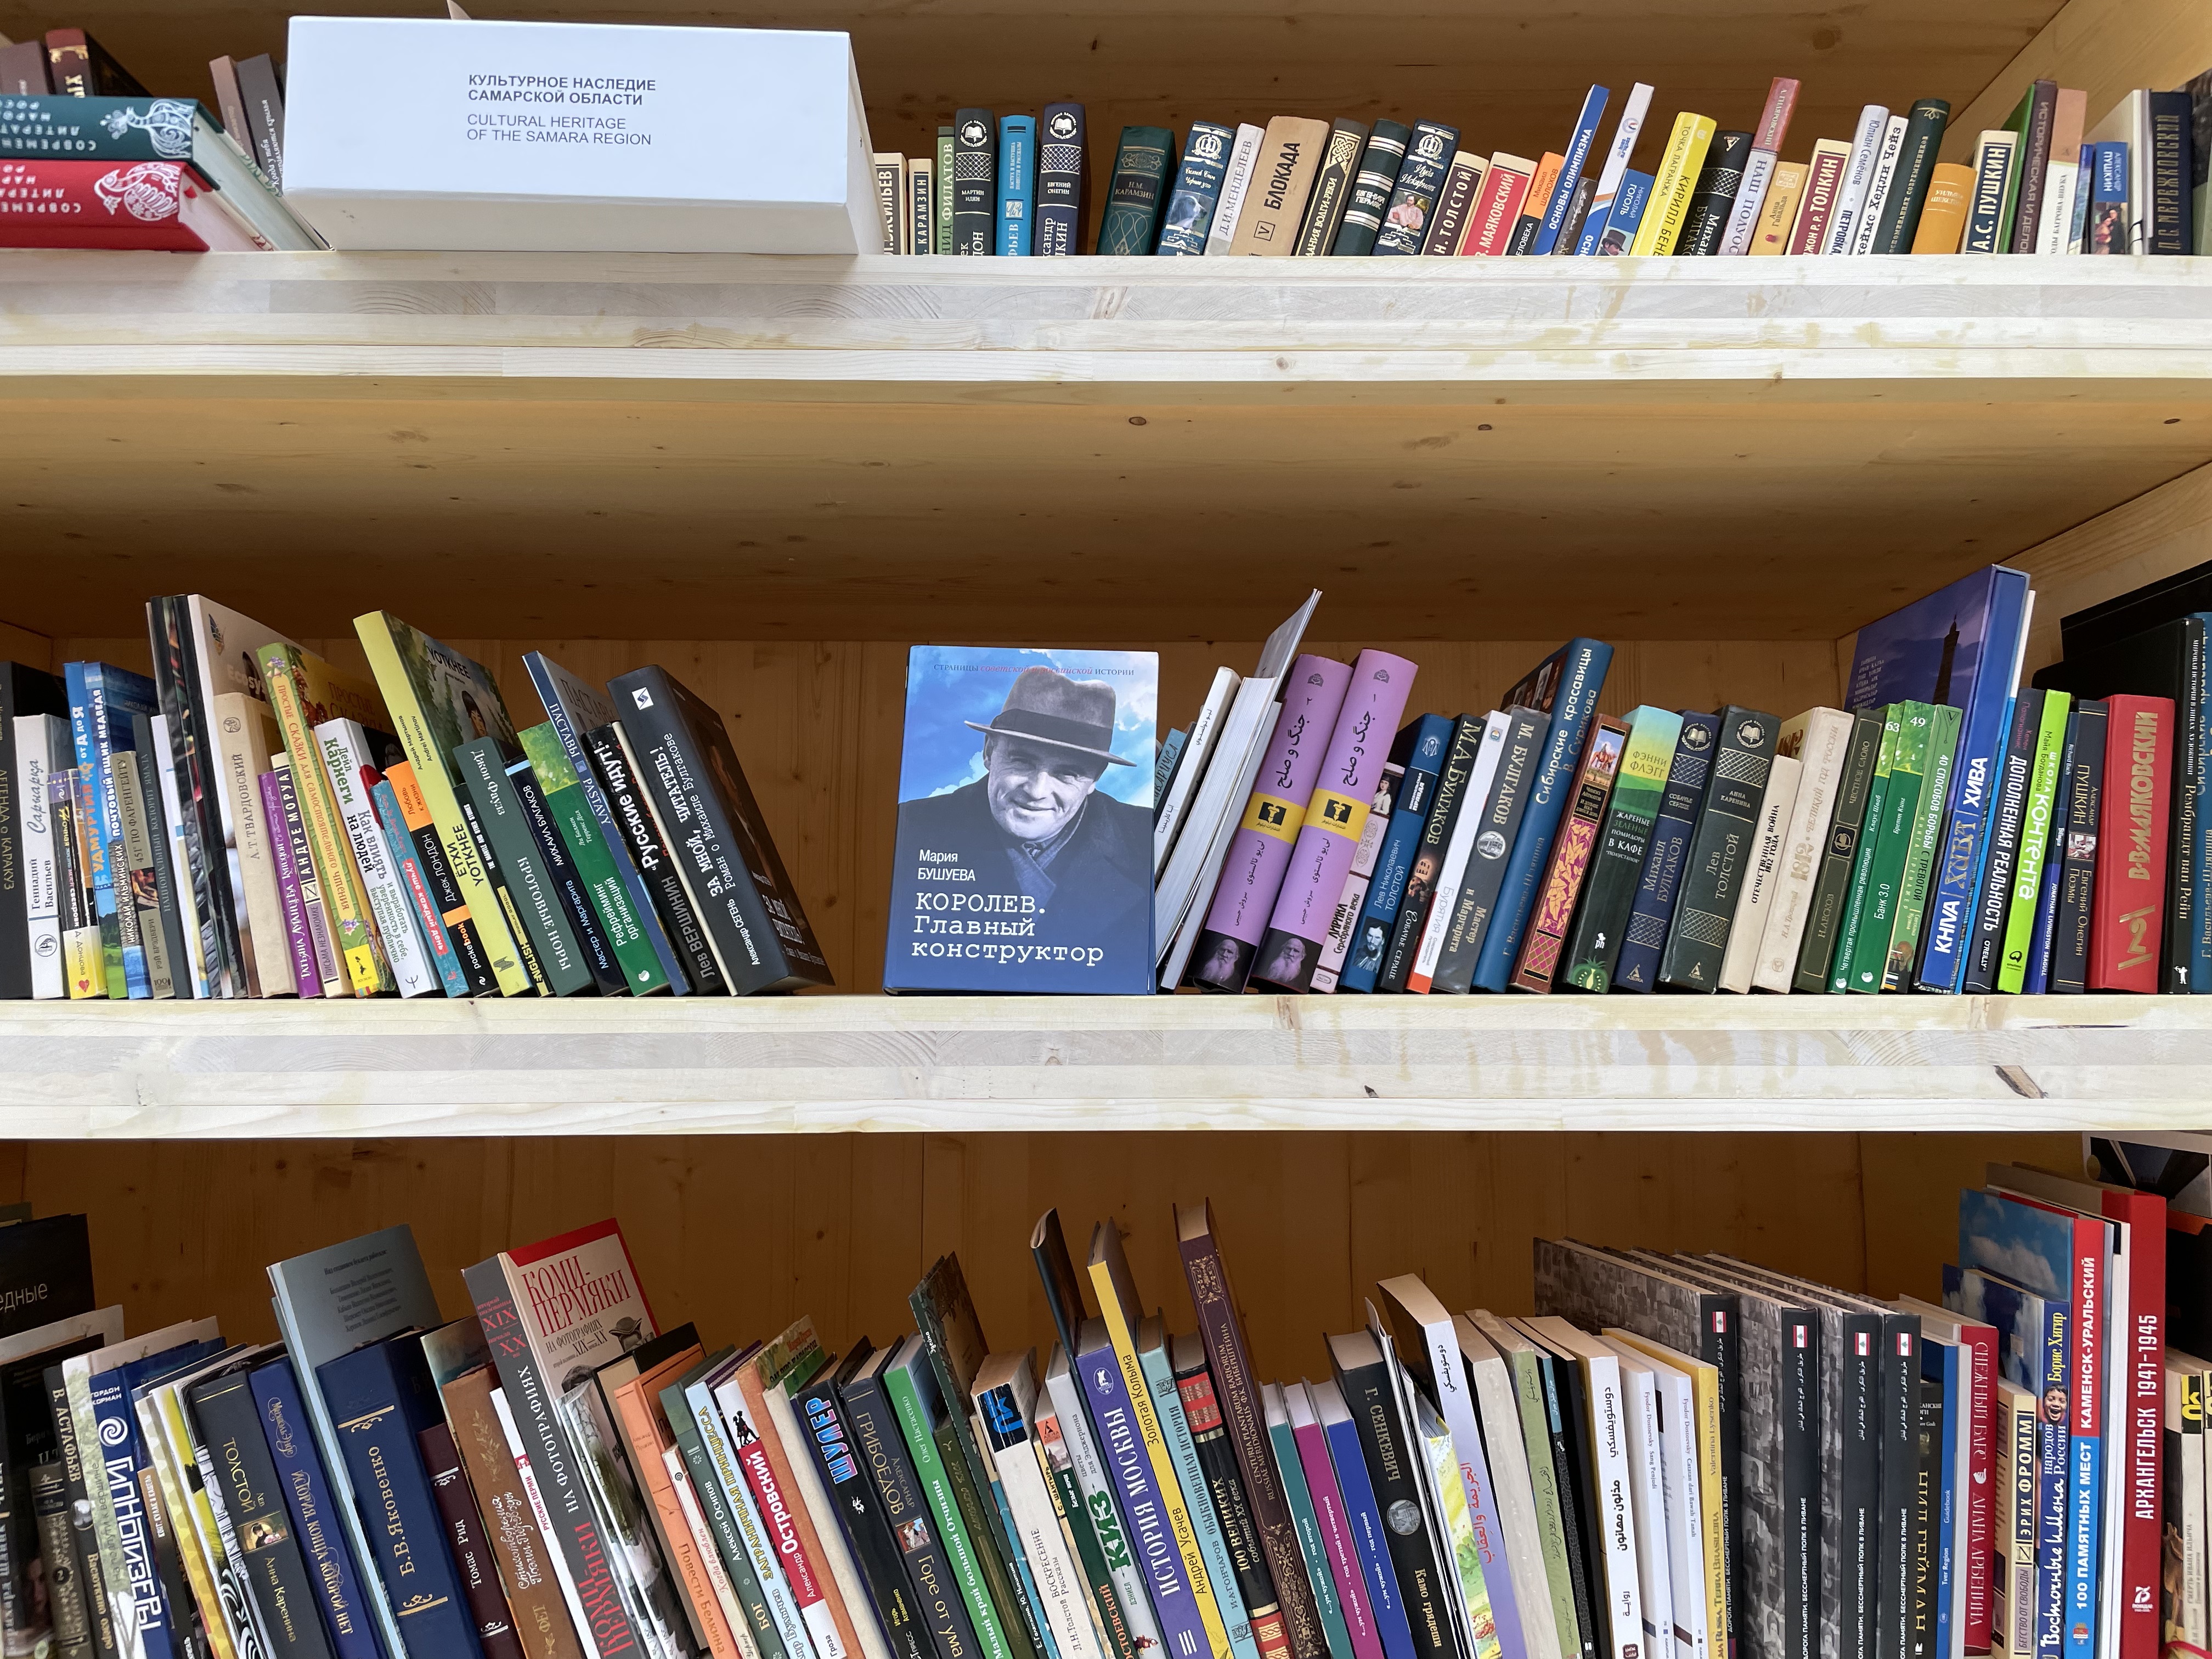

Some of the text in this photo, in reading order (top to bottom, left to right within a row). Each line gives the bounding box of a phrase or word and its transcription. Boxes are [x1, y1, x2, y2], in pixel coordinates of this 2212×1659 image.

[469, 75, 656, 91] КУЛЬТУРНОЕ НАСЛЕДИЕ
[469, 89, 642, 105] САМАРСКОЙ ОБЛАСТИ
[467, 114, 626, 129] CULTURAL HERITAGE
[467, 129, 651, 145] OF THE SAMARA REGION
[2027, 101, 2049, 202] ИСТОРИЧЕСКАЯ
[942, 143, 952, 221] ФИЛАТОВ
[1264, 143, 1300, 210] БЛОКАДА
[1541, 168, 1558, 206] ШОЛОХОВ
[1549, 189, 1570, 230] ОСНОВЫ
[1564, 128, 1592, 188] ОЛИМПИЗМА
[1660, 126, 1690, 196] ТОЧКА ЛАГРАНЖА
[1748, 160, 1767, 193] НАШ
[1810, 158, 1838, 212] ТОЛКИН
[1869, 127, 1901, 211] Хедли Чейз
[1978, 148, 2006, 215] ПУШКИН
[2103, 151, 2113, 191] ПУШКИН
[918, 179, 928, 244] КАРАМЗИН
[1115, 188, 1154, 200] КАРАМЗИН
[1440, 171, 1472, 236] ТОЛСТОЙ
[1479, 173, 1515, 249] МАЯКОВСКИЙ
[1620, 184, 1637, 215] ГОГОЛЬ
[1668, 176, 1691, 225] КИРИЛЛ
[549, 703, 580, 758] ПАСТАВЫ
[1536, 648, 1592, 805] Сибирские красавицы
[1886, 721, 1900, 732] 63
[1910, 717, 1925, 727] 49
[115, 759, 137, 823] ФАРЕНГЕЙТУ
[323, 737, 354, 805] Карнеги
[1492, 744, 1528, 825] БУЛГАКОВ
[1630, 761, 1664, 778] ФЛЭГГ
[1633, 751, 1666, 766] ФЭННИ
[236, 753, 255, 837] ТВАРДОВСКИЙ
[280, 774, 310, 877] АНДРЕ МОРУА
[583, 778, 611, 825] PASTAVY
[650, 746, 724, 898] ЗА ЧИТАТЕЛЬ!
[663, 733, 736, 889] Роман Михаиле Булгакове
[1616, 811, 1650, 827] ЖАРЕНЫЕ
[1720, 795, 1751, 808] КАРЕНИНА
[2074, 764, 2090, 825] ПУШКИН
[2181, 785, 2196, 856] Рембрандт
[354, 835, 374, 873] людей
[422, 833, 449, 880] ЛОНДОН
[452, 823, 486, 887] YOTKHEE
[919, 849, 958, 865] Мария
[1380, 839, 1401, 891] Николаевич
[1611, 830, 1645, 843] ПОМИДОРЫ
[1617, 840, 1643, 855] КАФЕ
[1643, 839, 1666, 891] Михаил
[1706, 851, 1720, 875] Лев
[1715, 834, 1739, 900] ТОЛСТОЙ
[1752, 805, 1779, 904] ОТЕЧЕСТВЕННАЯ ВОЙНА
[1934, 757, 1988, 953] KHIVA ХИВА
[1983, 755, 2027, 932] ДОПОЛНЕННАЯ РЕАЛЬНОСТЬ
[29, 859, 41, 909] Геннадий
[44, 860, 54, 907] Васильев
[918, 867, 975, 882] БУШУЕВА
[1385, 865, 1405, 911] ТОЛСТОЙ
[1657, 837, 1683, 902] БУЛГАКОВ
[2067, 867, 2079, 904] Поэмы
[516, 857, 571, 971] КРОТОВЫЕ НОРЫ
[565, 879, 608, 969] Мастер Маргарита
[593, 883, 627, 947] Рефрейминг
[605, 876, 639, 940] организаций
[661, 876, 707, 955] ВЕРШИНИН
[913, 915, 1035, 937] Главный
[916, 892, 1045, 913] КОРОЛЕВ.
[1449, 896, 1474, 952] Маргарита
[2074, 870, 2092, 956] Евгений Онегин
[911, 941, 1103, 967] конструктор
[521, 1255, 591, 1303] КОМИ-
[533, 1270, 631, 1338] ПЕРМЯКИ
[558, 1319, 602, 1350] ФОТОГРАФИЯХ
[2080, 1257, 2095, 1429] КАМЕНСК-УРАЛЬСКИЙ
[55, 1406, 81, 1483] АСТАФЬЕВ
[517, 1365, 571, 1488] ФОТОГРАФИЯХ
[805, 1397, 859, 1485] ШУЛЕР
[916, 1438, 930, 1464] Олег
[1369, 1404, 1401, 1482] СЕНКЕВИЧ
[222, 1437, 255, 1513] ТОЛСТОЙ
[857, 1412, 904, 1515] ГРИБОЕДОВ
[891, 1457, 915, 1508] АЛЕКСАНДР
[1122, 1355, 1207, 1594] Андрей Усачев Золотая Колыма
[1169, 1404, 1216, 1535] ОБЫКНОВЕННАЯ ИСТОРИЯ
[2018, 1419, 2032, 1536] ЭРИХ ФРОММ
[2135, 1407, 2155, 1520] АРХАНГЕЛЬСК
[567, 1489, 580, 1513] НА
[704, 1481, 742, 1561] Алексей Осипов
[1103, 1407, 1181, 1598] ИСТОРИЯ МОСКВЫ
[2076, 1442, 2091, 1577] ПАМЯТНЫХ МЕСТ
[105, 1456, 162, 1629] ГИПНОТИЗЕРЫ
[455, 1519, 483, 1589] Томас Рид
[749, 1452, 838, 1657] Гроза Александр ОСТРОВСКИЙ
[1030, 1528, 1059, 1600] ВОСКРЕСЕНИЕ
[1087, 1491, 1137, 1605] ДЭНИЕЛ КИЗ
[264, 1556, 296, 1643] Анна Каренина
[679, 1543, 725, 1654] Повести Белкина
[751, 1602, 770, 1630] БОГ
[918, 1555, 963, 1658] Горе от ума
